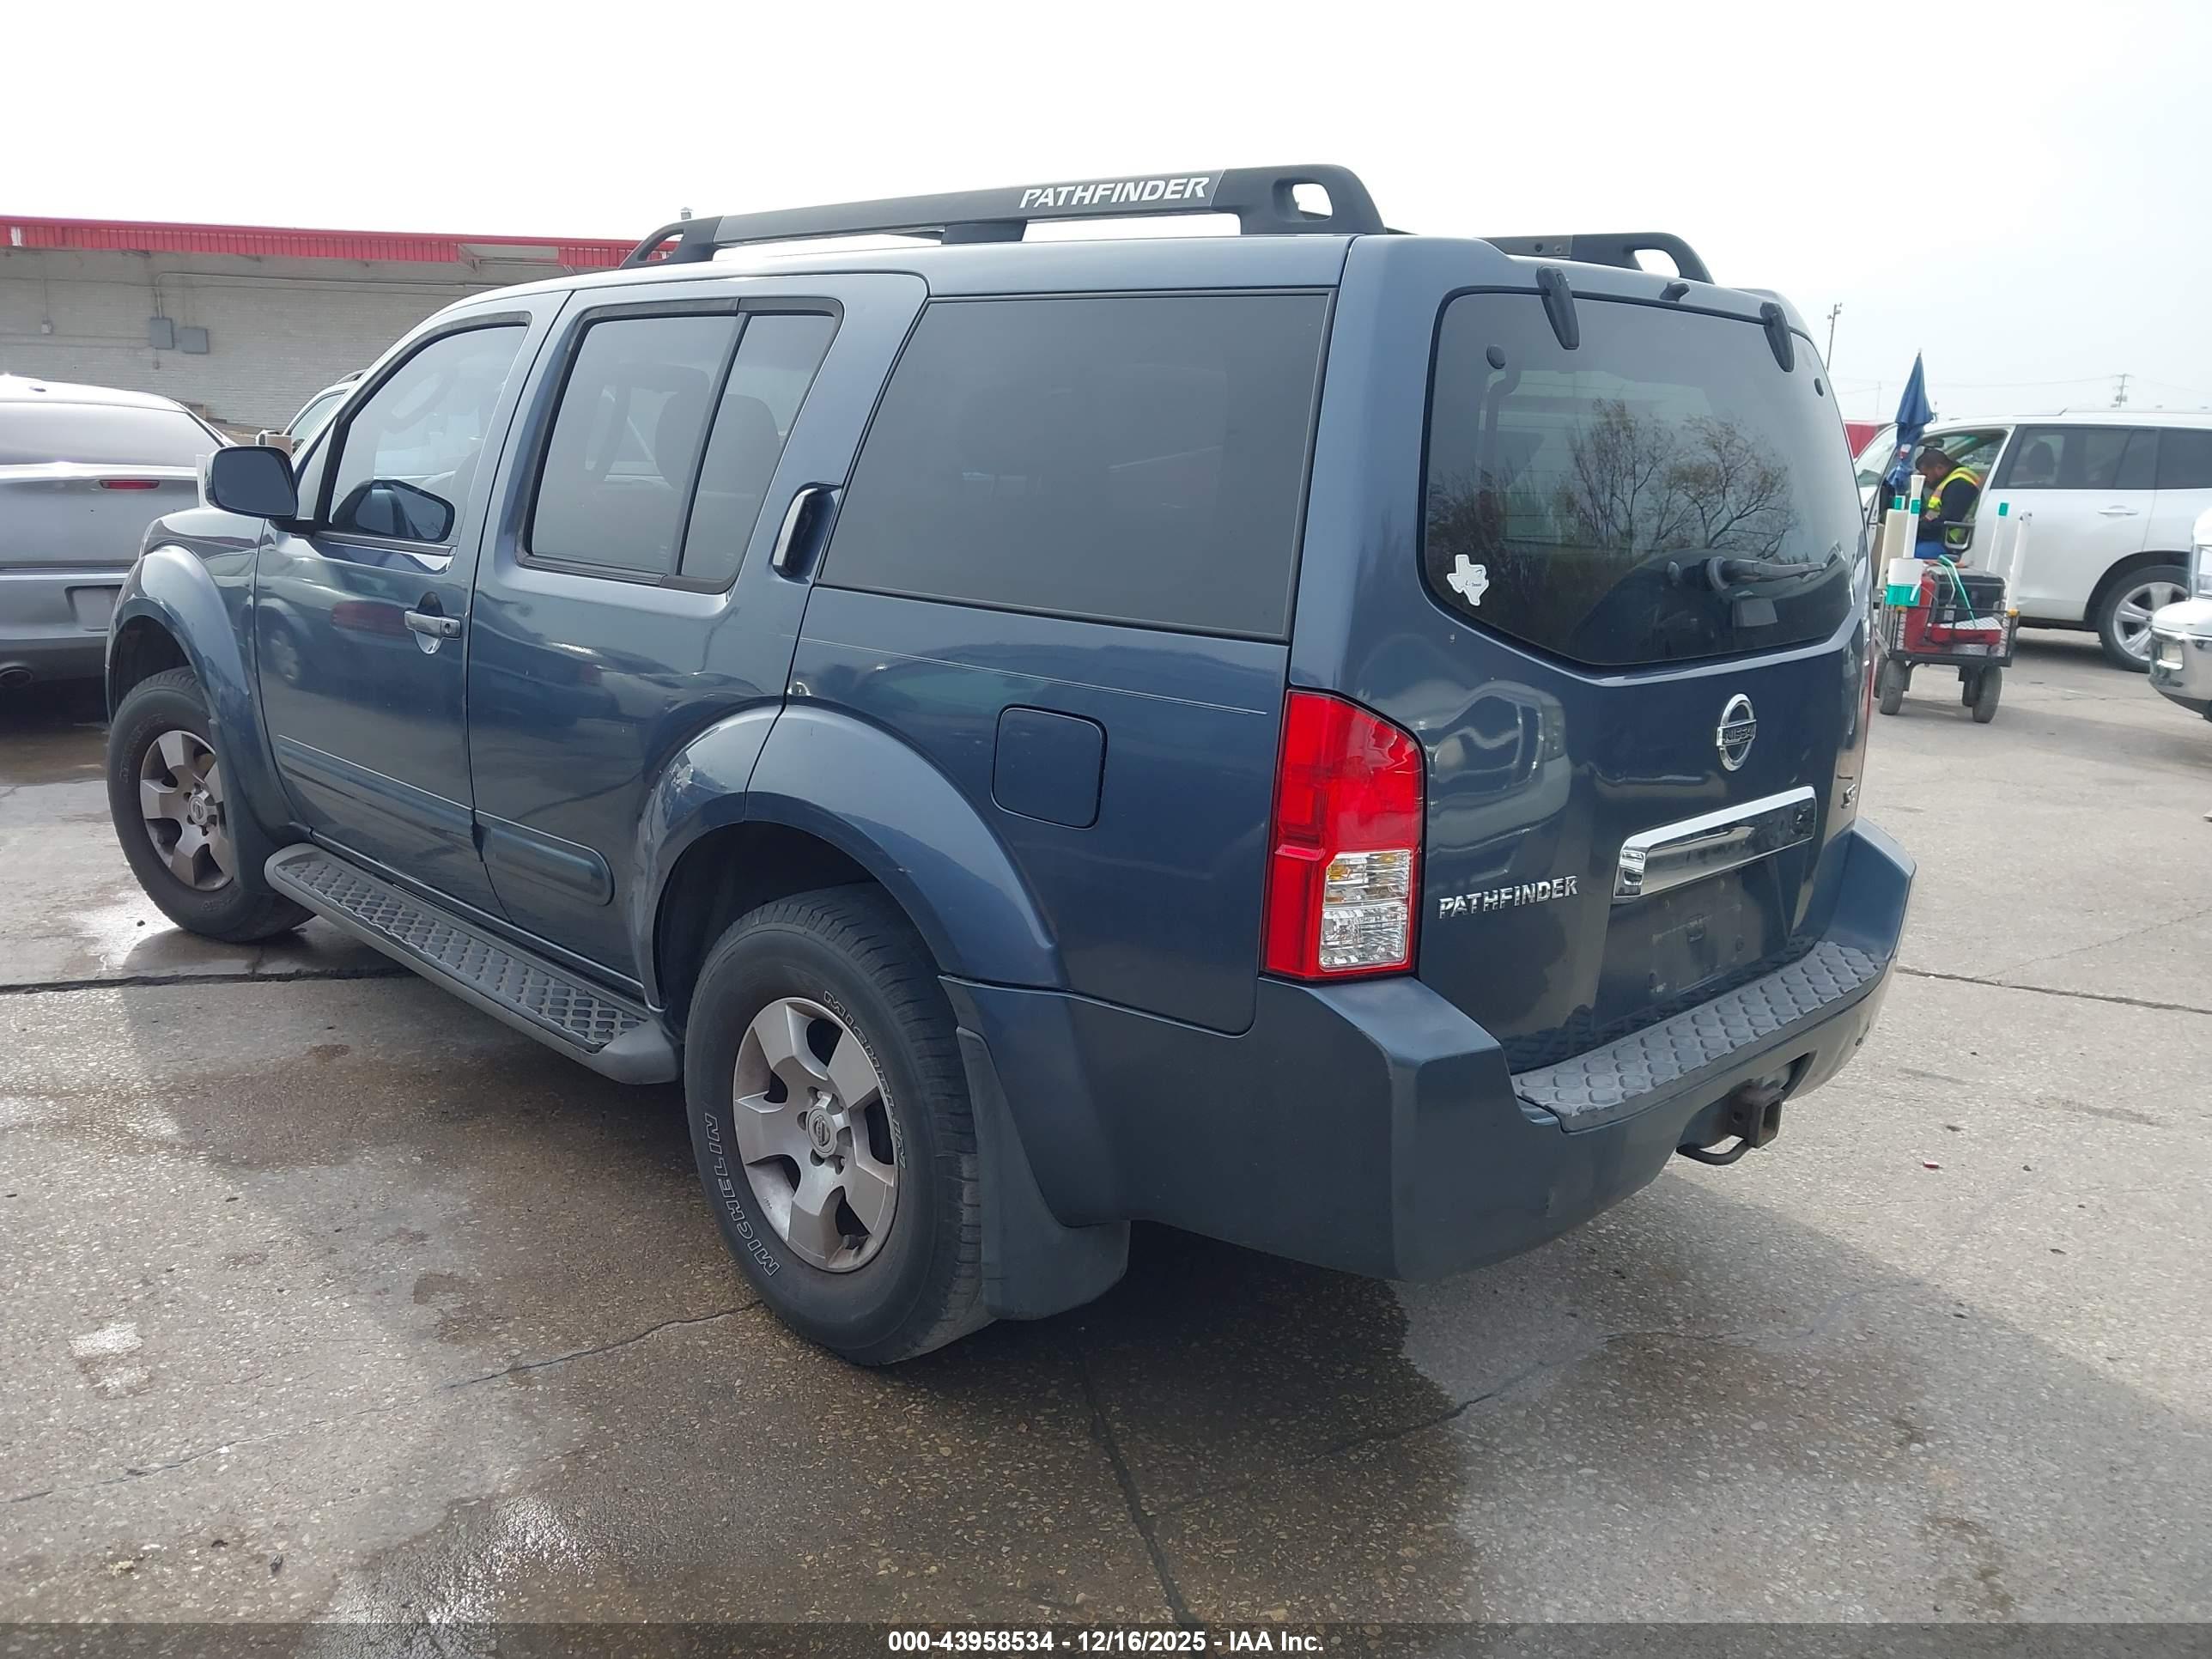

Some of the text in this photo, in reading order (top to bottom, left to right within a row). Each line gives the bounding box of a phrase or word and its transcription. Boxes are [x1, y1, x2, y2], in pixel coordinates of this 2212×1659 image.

[1018, 176, 1210, 210] PATHFINDER
[1437, 875, 1580, 919] PATHFINDER
[704, 1112, 781, 1277] MICHELIN
